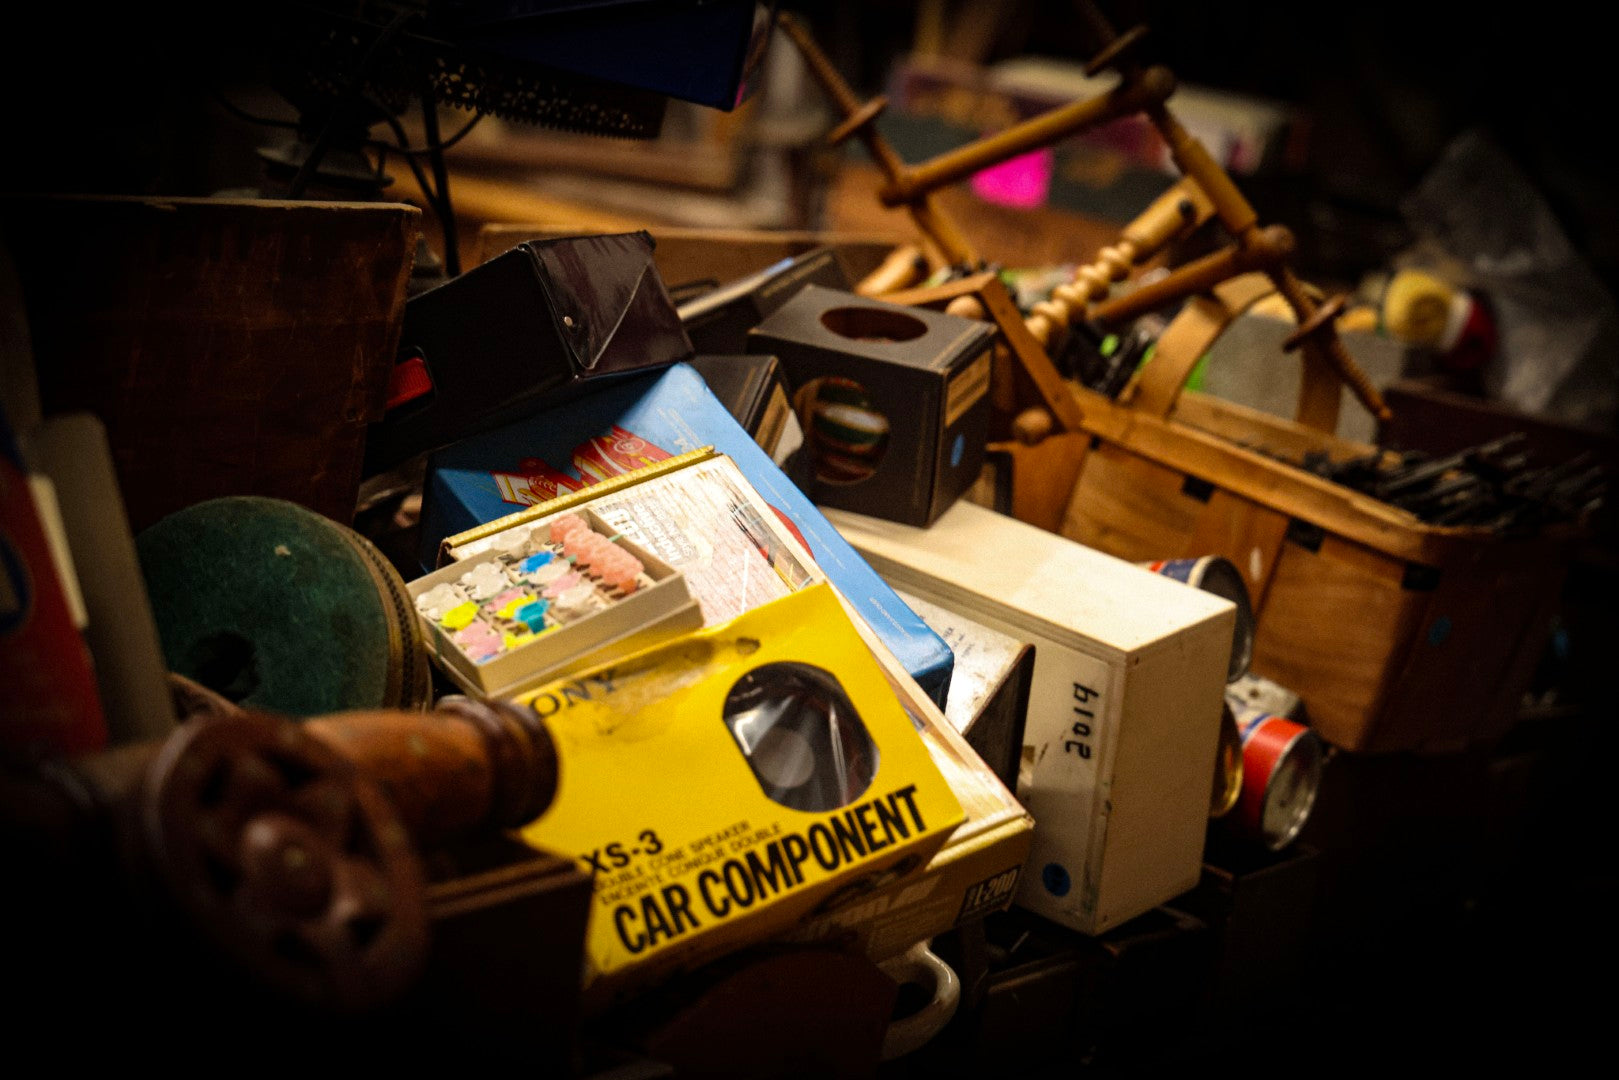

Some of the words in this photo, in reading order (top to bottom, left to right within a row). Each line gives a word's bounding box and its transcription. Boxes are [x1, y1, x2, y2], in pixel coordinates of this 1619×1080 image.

[529, 668, 617, 717] ONY
[1065, 682, 1099, 759] 2019
[580, 829, 663, 873] XS-3
[689, 821, 749, 851] SPEAKER
[614, 884, 700, 953] CAR
[699, 785, 926, 917] COMPONENT
